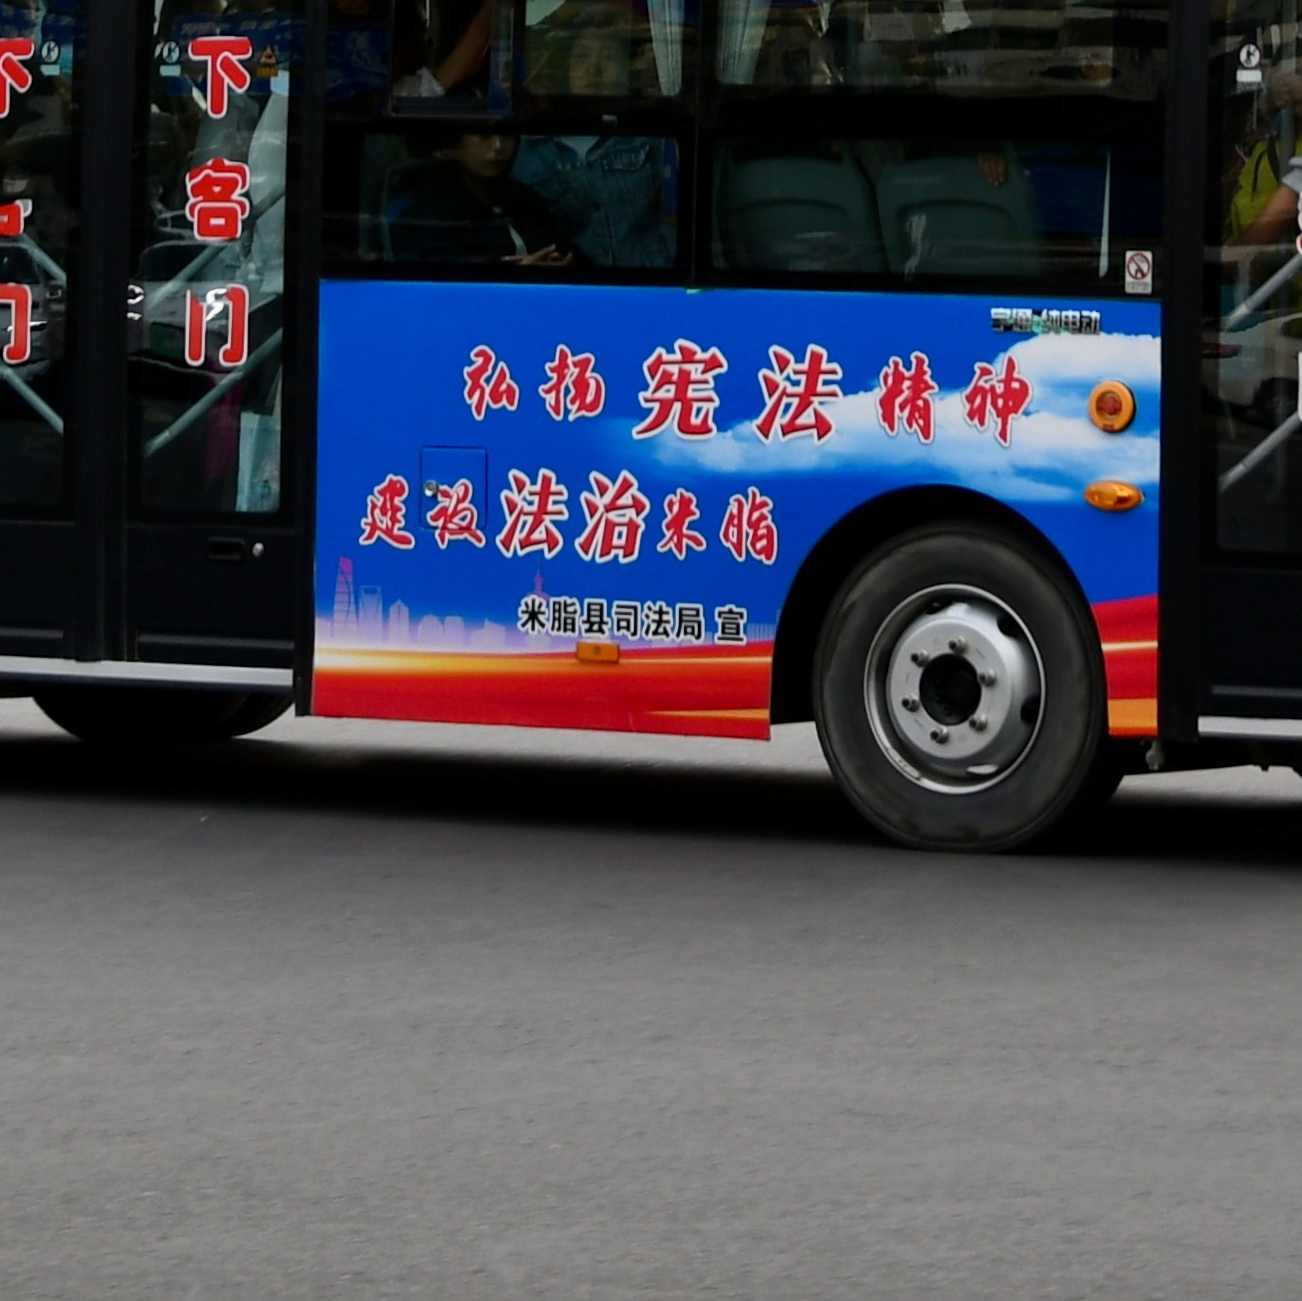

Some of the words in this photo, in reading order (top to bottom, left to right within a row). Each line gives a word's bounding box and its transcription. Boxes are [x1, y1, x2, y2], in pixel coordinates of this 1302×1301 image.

[462, 339, 1033, 447] 弘扬宪法精神
[358, 467, 779, 565] 建设法治米脂
[518, 594, 706, 642] 米脂县司法局
[714, 605, 747, 646] 宣
